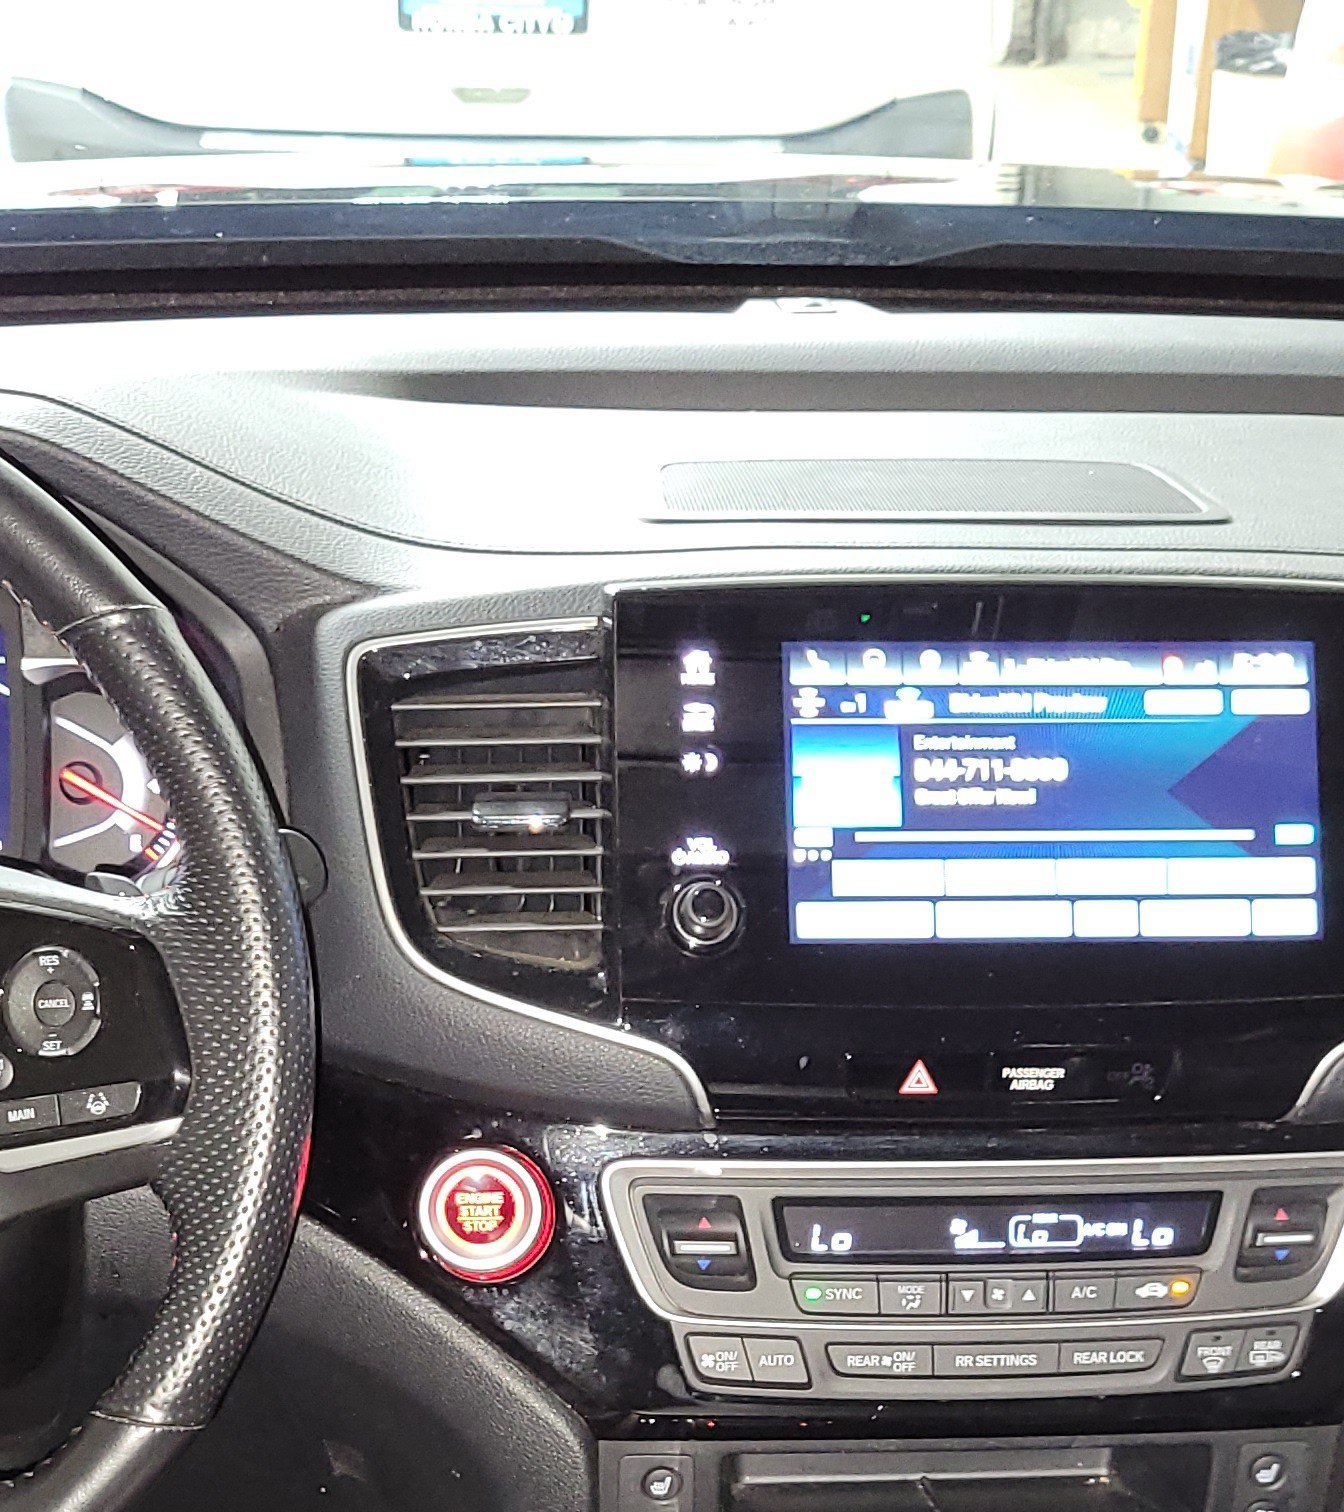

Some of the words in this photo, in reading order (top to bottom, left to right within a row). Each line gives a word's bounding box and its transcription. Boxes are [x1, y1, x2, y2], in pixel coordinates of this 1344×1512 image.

[39, 955, 60, 966] RES
[37, 998, 71, 1009] CANCEL
[42, 1040, 63, 1051] SET
[1001, 1067, 1066, 1079] PASSENGER
[1009, 1079, 1055, 1091] AIRBAG
[7, 1106, 36, 1122] MAIN
[454, 1191, 505, 1204] ENGINE
[459, 1204, 501, 1217] START
[461, 1220, 499, 1232] STOP
[810, 1224, 853, 1252] Lo
[1131, 1218, 1175, 1247] Lo
[825, 1287, 863, 1301] SYNC
[897, 1285, 925, 1295] MODE
[1071, 1285, 1098, 1300] A/C
[1253, 1340, 1283, 1350] REAR
[715, 1351, 738, 1361] ON/
[1073, 1352, 1109, 1365] REAR
[1109, 1350, 1145, 1364] LOCK
[1197, 1345, 1233, 1358] FRONT
[758, 1355, 795, 1367] AUTO
[846, 1355, 880, 1367] REAR
[892, 1351, 916, 1361] ON/
[955, 1354, 975, 1367] RR
[975, 1354, 1038, 1367] SETTINGS
[715, 1362, 739, 1372] OFF
[892, 1362, 916, 1372] OFF
